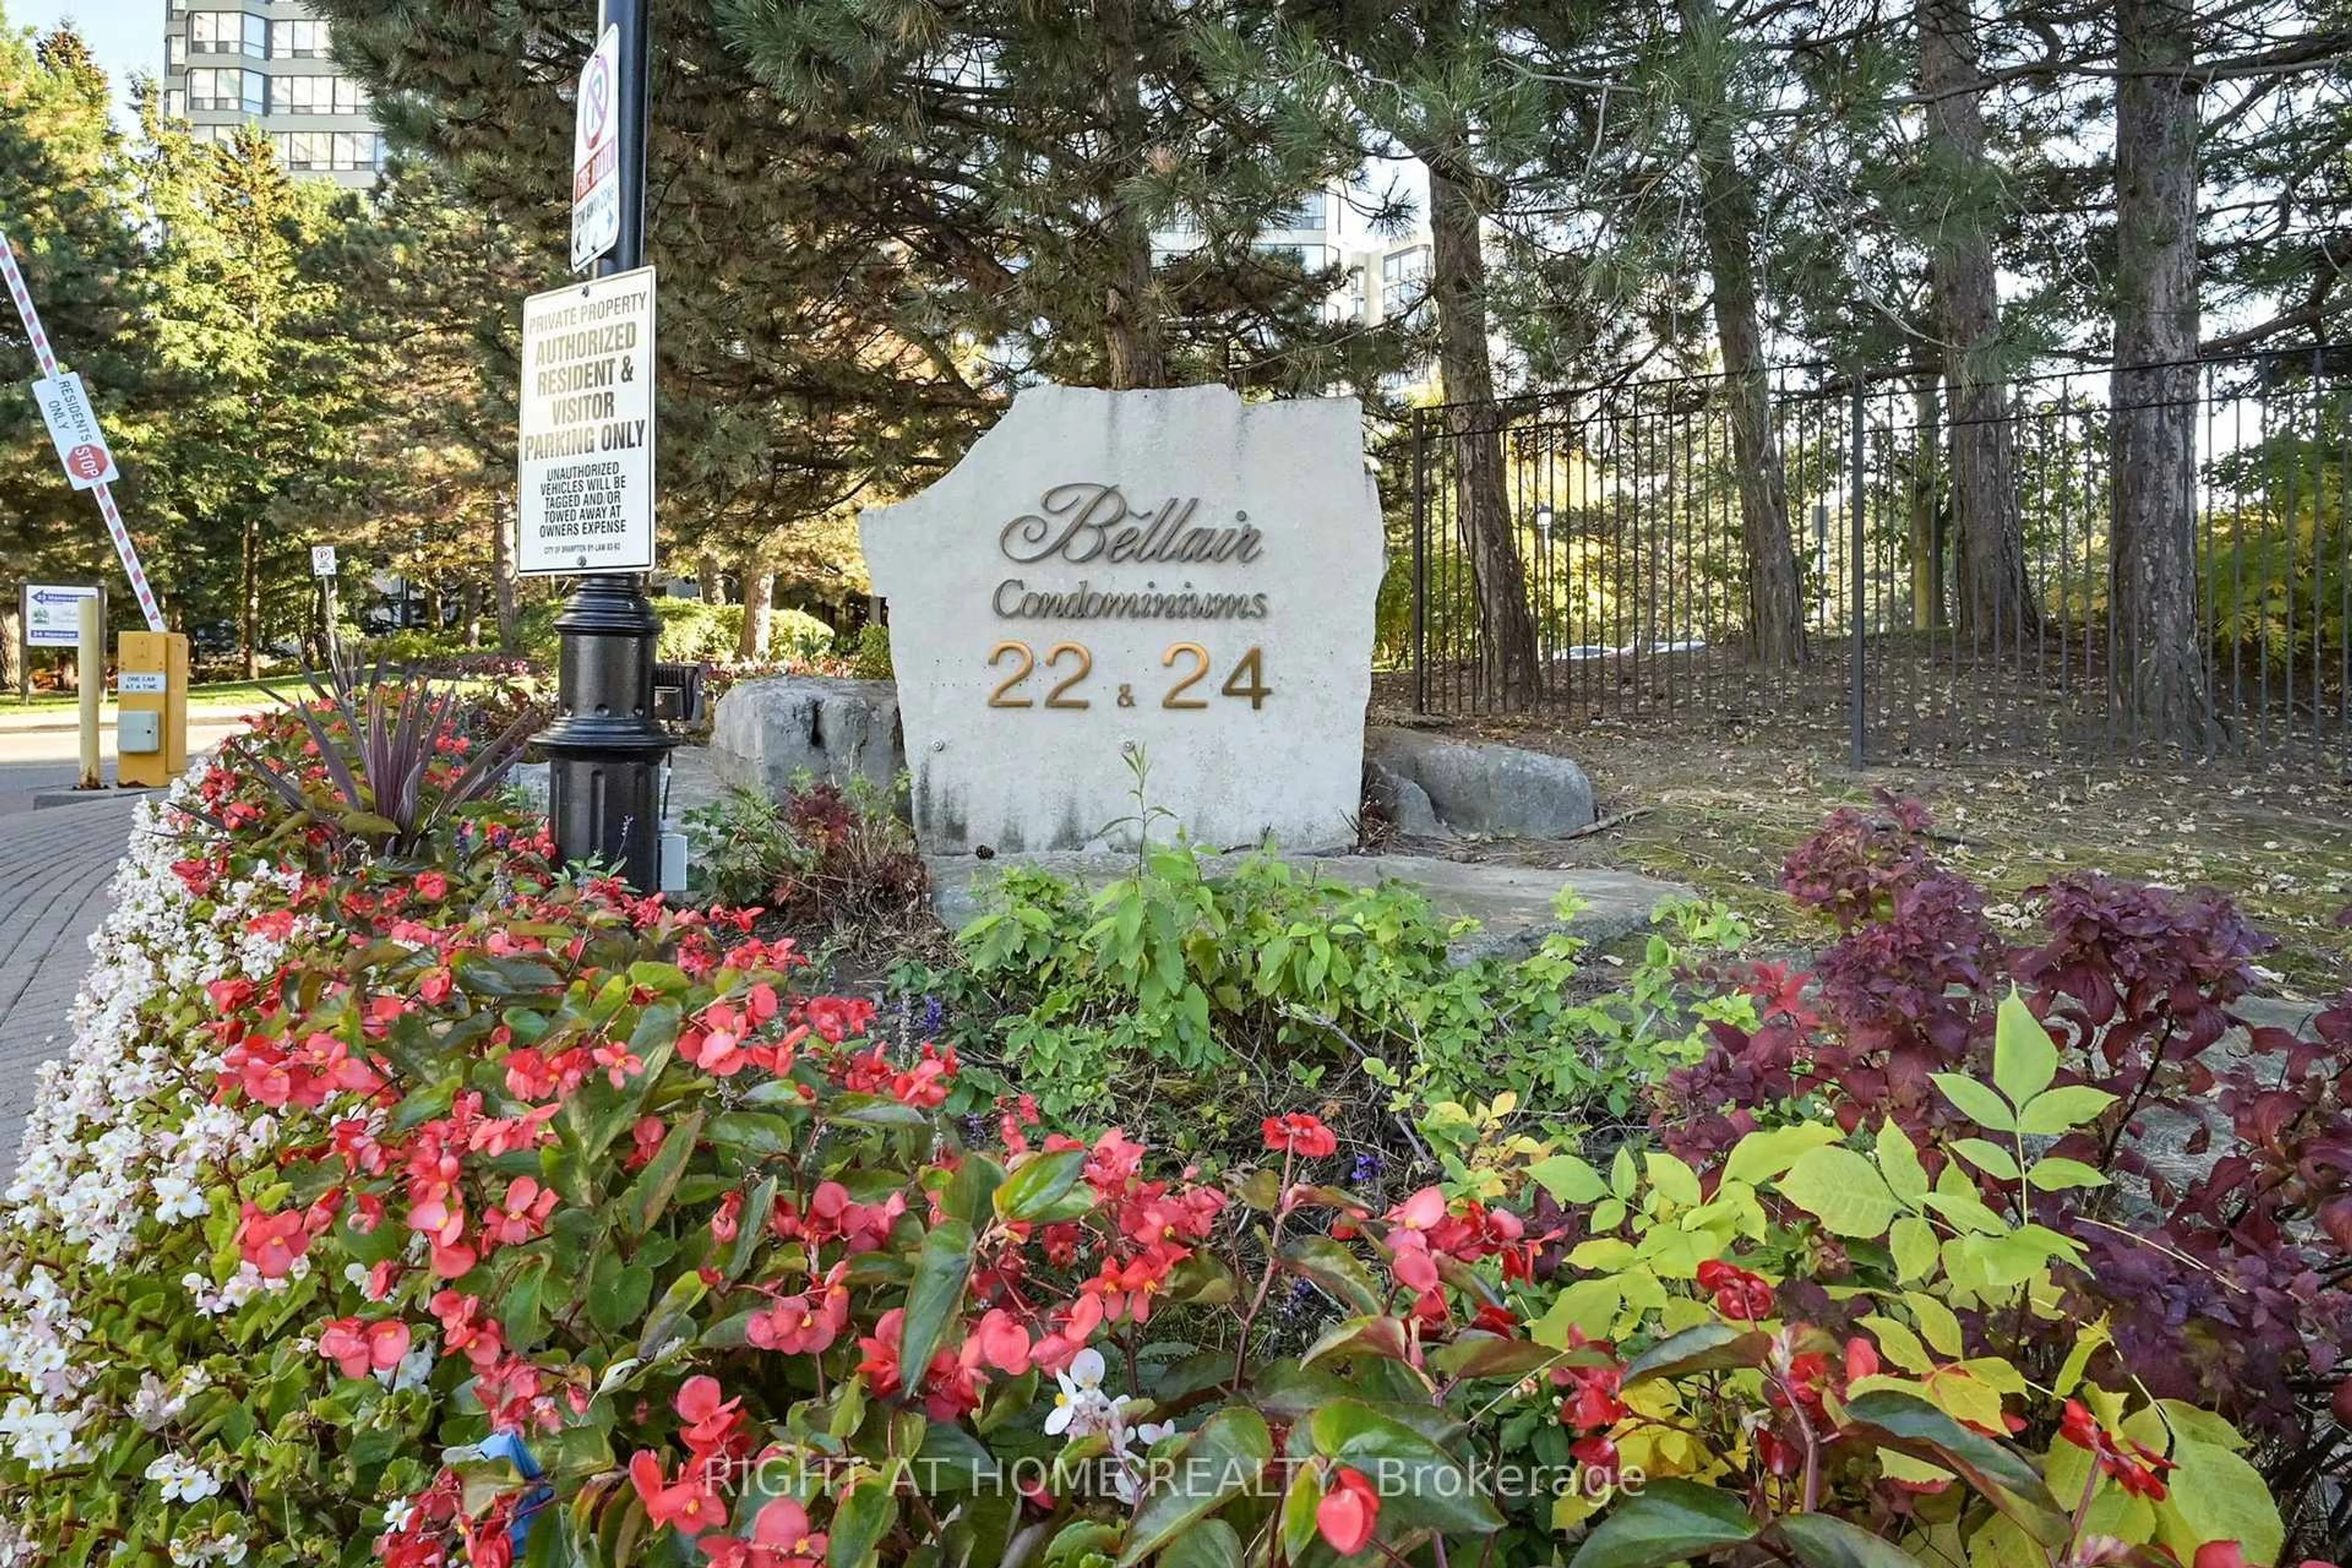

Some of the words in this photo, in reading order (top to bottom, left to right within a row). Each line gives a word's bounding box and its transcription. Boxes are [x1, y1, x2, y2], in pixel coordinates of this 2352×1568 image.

[529, 307, 576, 334] PRIVATE
[581, 291, 647, 323] PROPERTY
[535, 321, 637, 366] AUTHORIZED
[537, 358, 616, 397] RESIDENT
[620, 355, 633, 383] &
[48, 400, 69, 430] ONLY
[59, 380, 92, 442] RESIDENTS
[552, 391, 615, 426] VISITOR
[524, 426, 595, 461] PARKING
[601, 420, 646, 451] ONLY
[75, 446, 99, 477] STOP
[547, 461, 620, 481] UNAUTHORIZED
[540, 480, 584, 496] VEHICLES
[586, 477, 611, 492] WILL
[614, 475, 626, 489] BE
[545, 494, 580, 510] TAGGED
[583, 491, 621, 507] AND/OR
[540, 522, 579, 538] OWNERS
[582, 519, 627, 535] EXPENSE
[544, 508, 576, 524] TOWED
[579, 507, 607, 521] AWAY
[609, 505, 622, 518] AT
[1000, 481, 1264, 565] Bellair
[991, 578, 1268, 621] Condominiums
[987, 639, 1093, 709] 22
[1117, 684, 1136, 708] &
[1162, 641, 1273, 710] 24
